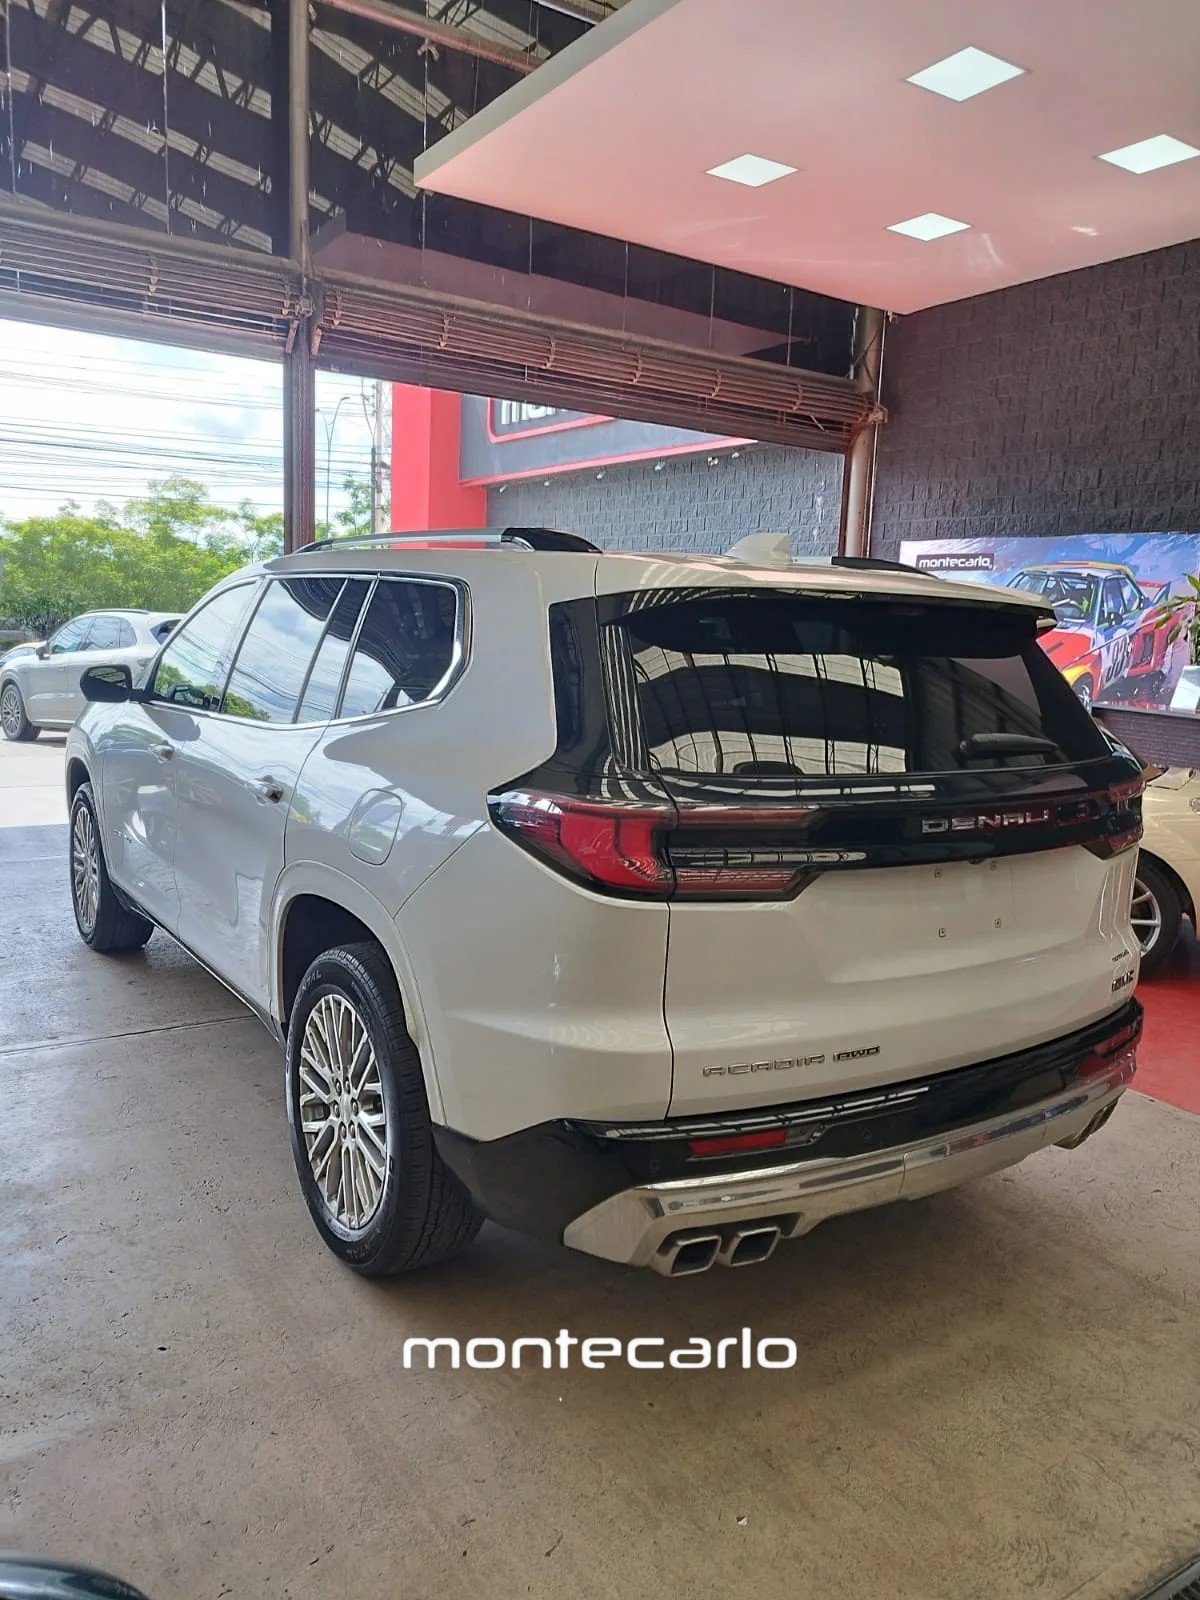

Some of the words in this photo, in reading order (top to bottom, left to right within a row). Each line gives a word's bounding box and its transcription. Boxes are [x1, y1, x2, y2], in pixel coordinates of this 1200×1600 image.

[919, 555, 990, 569] montecarlo
[921, 810, 1049, 834] DENALI
[702, 1053, 826, 1077] ACADIA
[832, 1045, 881, 1062] AWD
